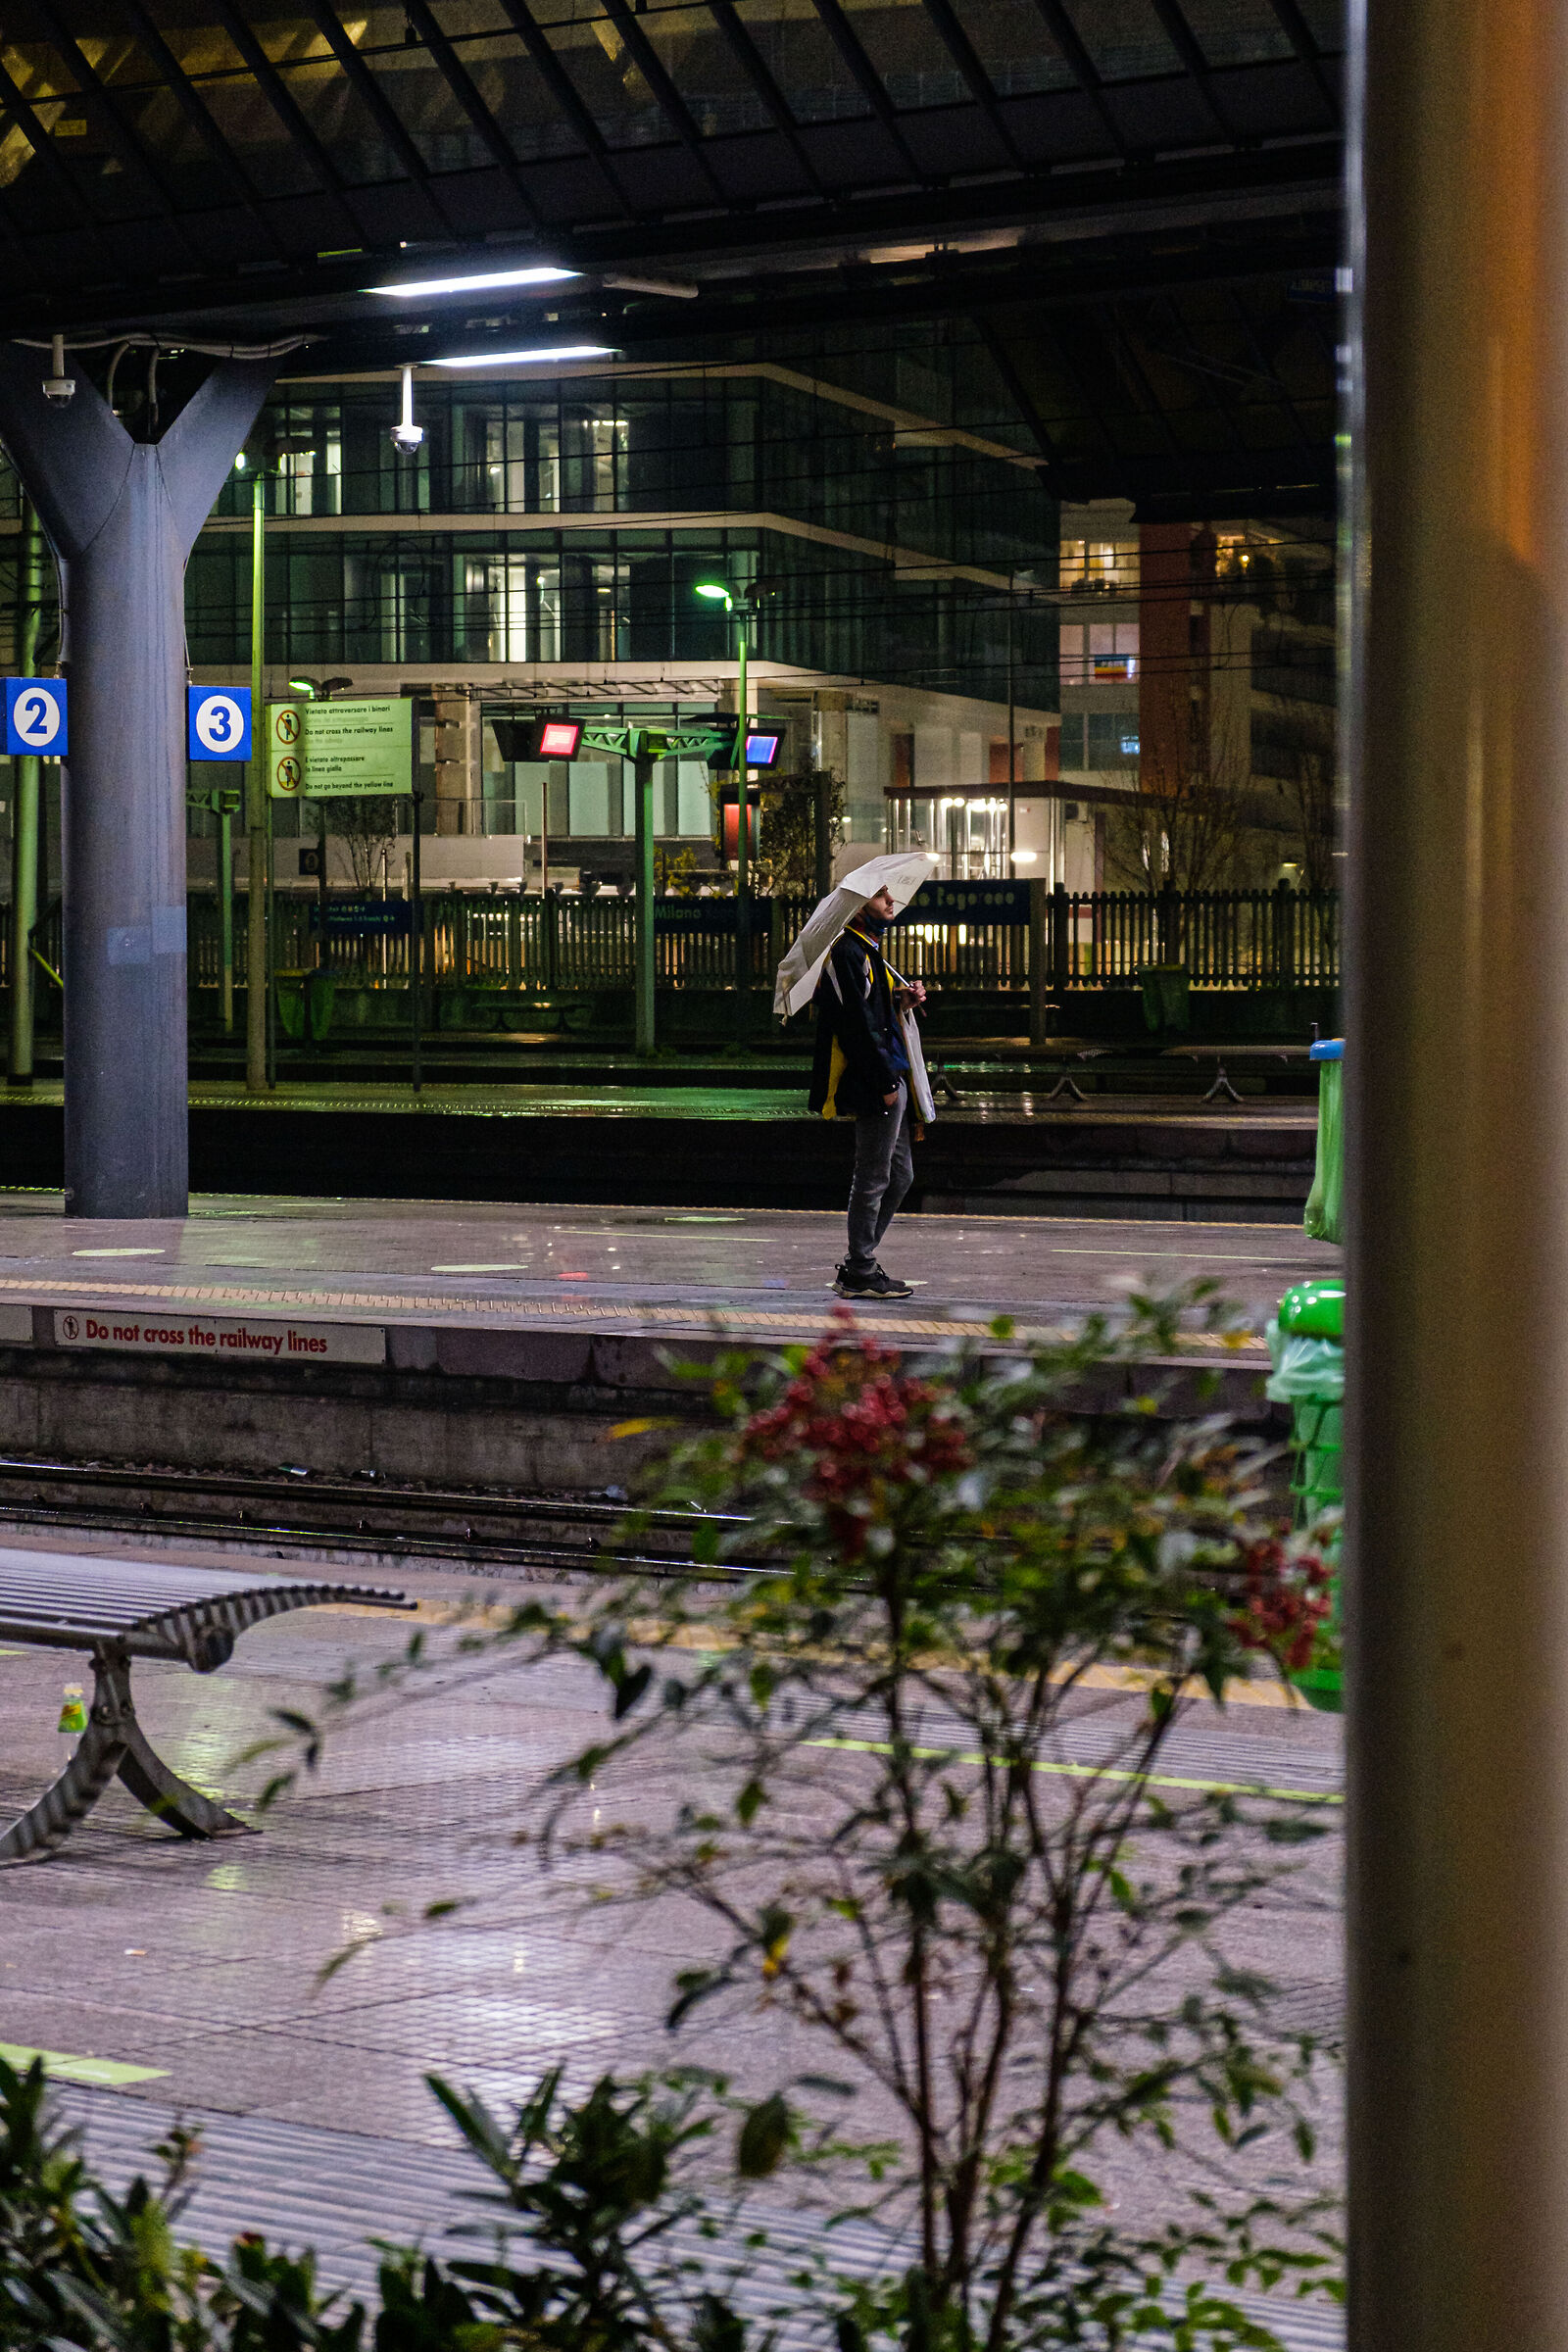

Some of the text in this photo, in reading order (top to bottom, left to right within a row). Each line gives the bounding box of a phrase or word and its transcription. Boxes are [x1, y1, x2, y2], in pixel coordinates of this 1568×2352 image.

[24, 696, 48, 735] 2
[208, 705, 232, 743] 3
[354, 726, 377, 735] railway
[331, 781, 352, 790] beyond
[364, 780, 382, 789] yellow
[654, 904, 703, 920] Milano
[85, 1318, 328, 1356] Do not cross the railway lines
